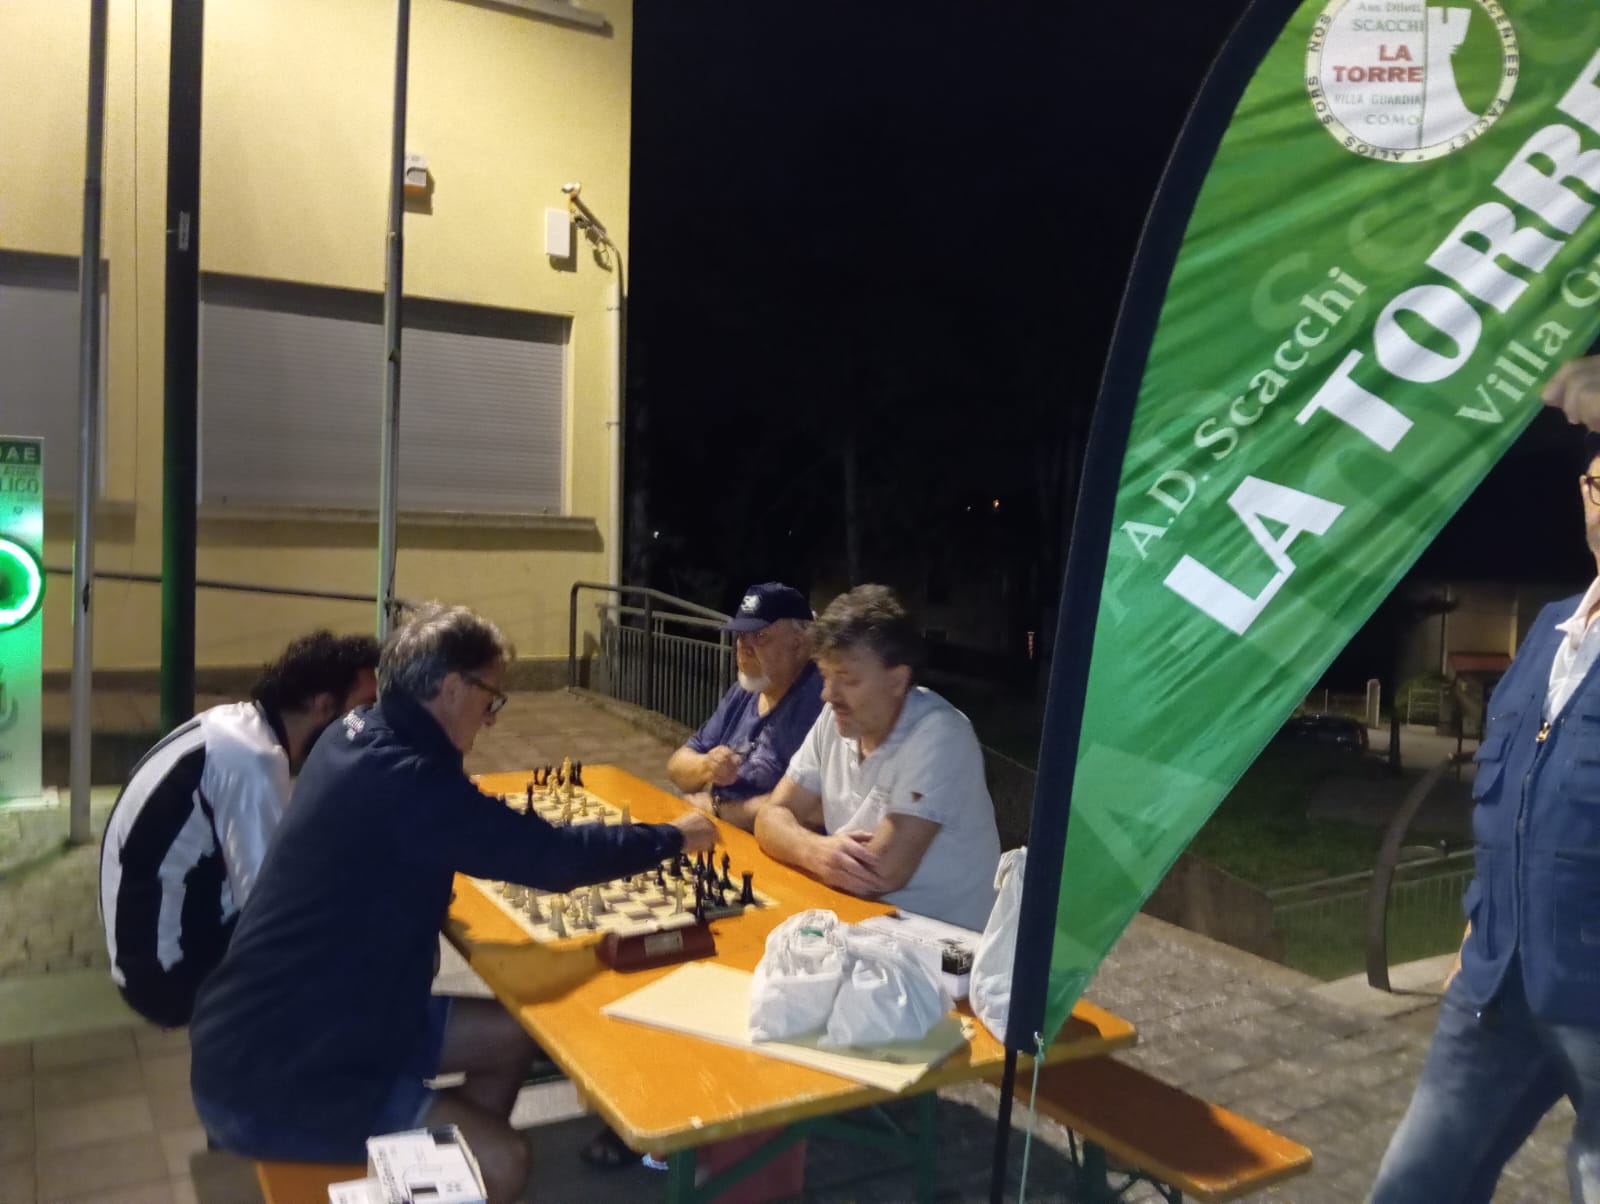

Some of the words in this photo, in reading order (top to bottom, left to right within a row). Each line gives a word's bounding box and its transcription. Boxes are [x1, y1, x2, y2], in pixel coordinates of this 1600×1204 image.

[1308, 13, 1332, 53] NOS
[1352, 18, 1425, 32] SCACCHI
[1379, 44, 1413, 62] LA
[1332, 65, 1425, 83] TORRE
[1308, 75, 1334, 126] SORS
[1334, 93, 1364, 106] VILLA
[1371, 93, 1422, 106] GUARDIA
[1364, 113, 1421, 126] COMO
[1449, 98, 1508, 151] FACIET
[1343, 135, 1405, 161] ALIOS
[1194, 265, 1368, 461] Scacchi
[1455, 319, 1573, 424] Villa
[1163, 475, 1345, 636] LA
